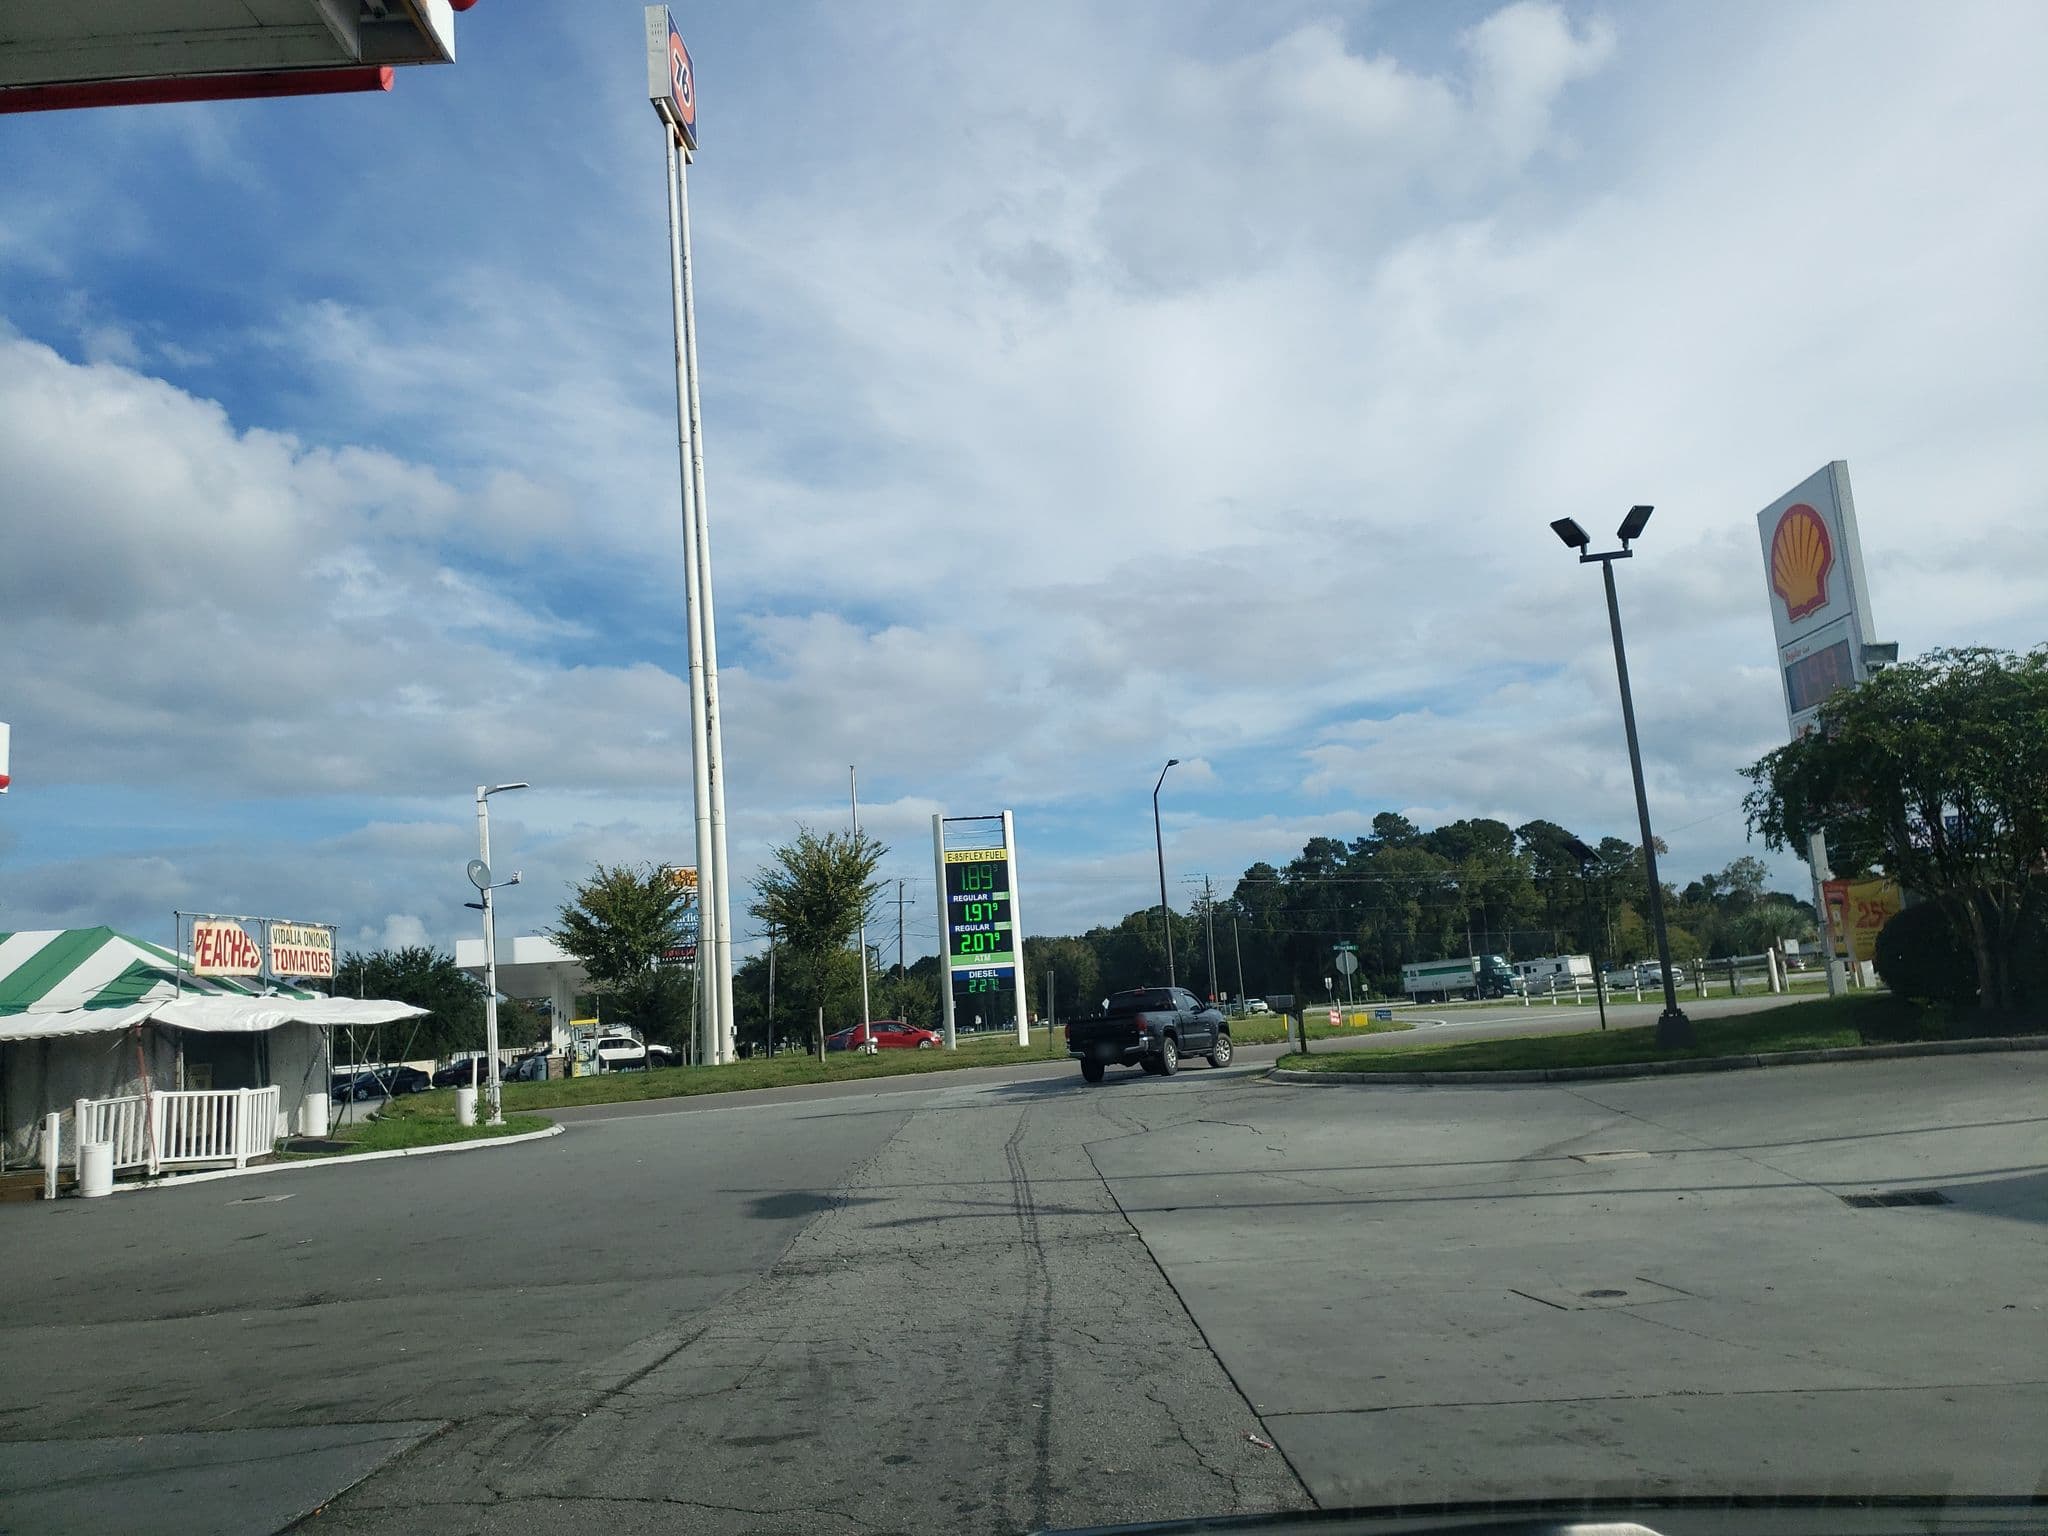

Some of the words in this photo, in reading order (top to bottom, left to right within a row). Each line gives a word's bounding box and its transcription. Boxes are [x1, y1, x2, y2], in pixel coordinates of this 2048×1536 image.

[673, 47, 692, 108] 76
[985, 850, 1005, 860] FUEL
[953, 893, 988, 903] REGULAR
[954, 923, 990, 933] REGULAR
[272, 927, 303, 946] VIDALIA
[303, 930, 330, 949] ONIONS
[195, 928, 261, 969] PEACHES
[273, 948, 331, 974] TOMATOES
[974, 953, 992, 962] ATM
[968, 969, 999, 979] DIESEL
